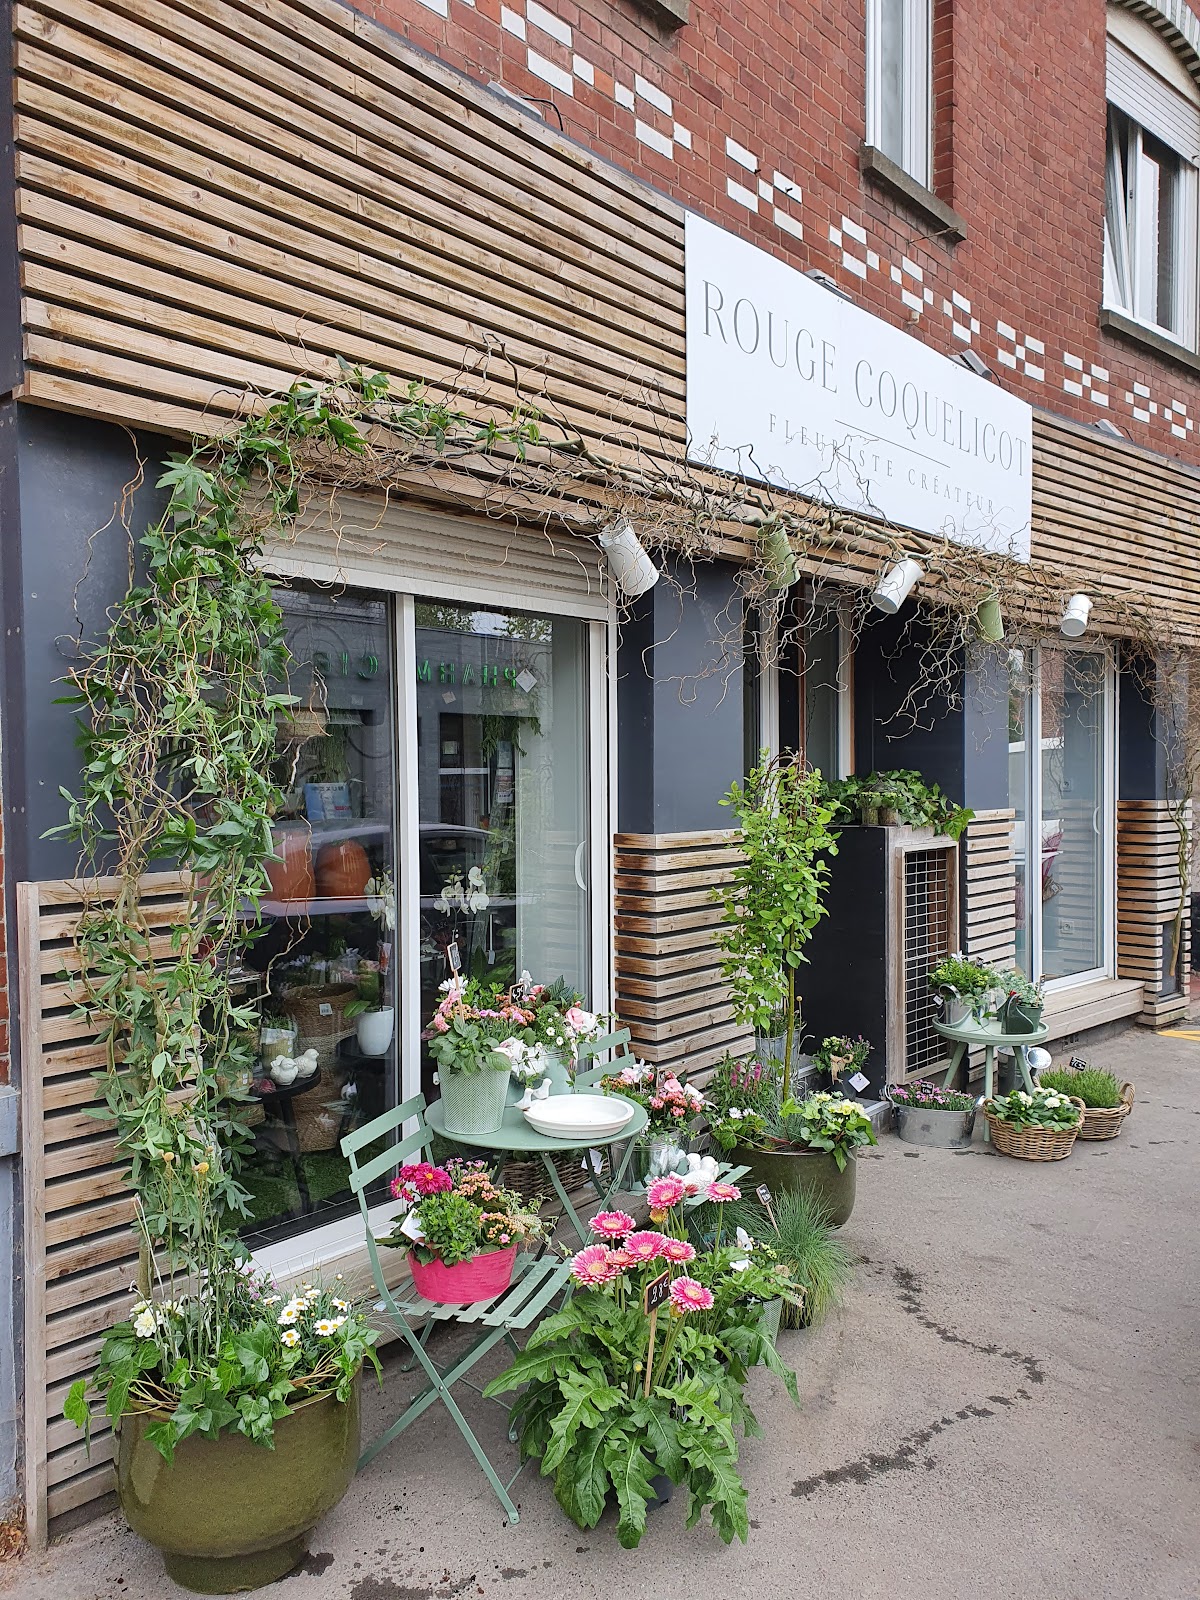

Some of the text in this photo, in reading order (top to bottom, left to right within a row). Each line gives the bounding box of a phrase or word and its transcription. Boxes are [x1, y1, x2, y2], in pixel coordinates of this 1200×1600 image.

[702, 279, 1027, 477] ROUGE COQUELICOT
[769, 413, 994, 515] FLEURISTE CRÉATEUR
[650, 1276, 669, 1304] 28€
